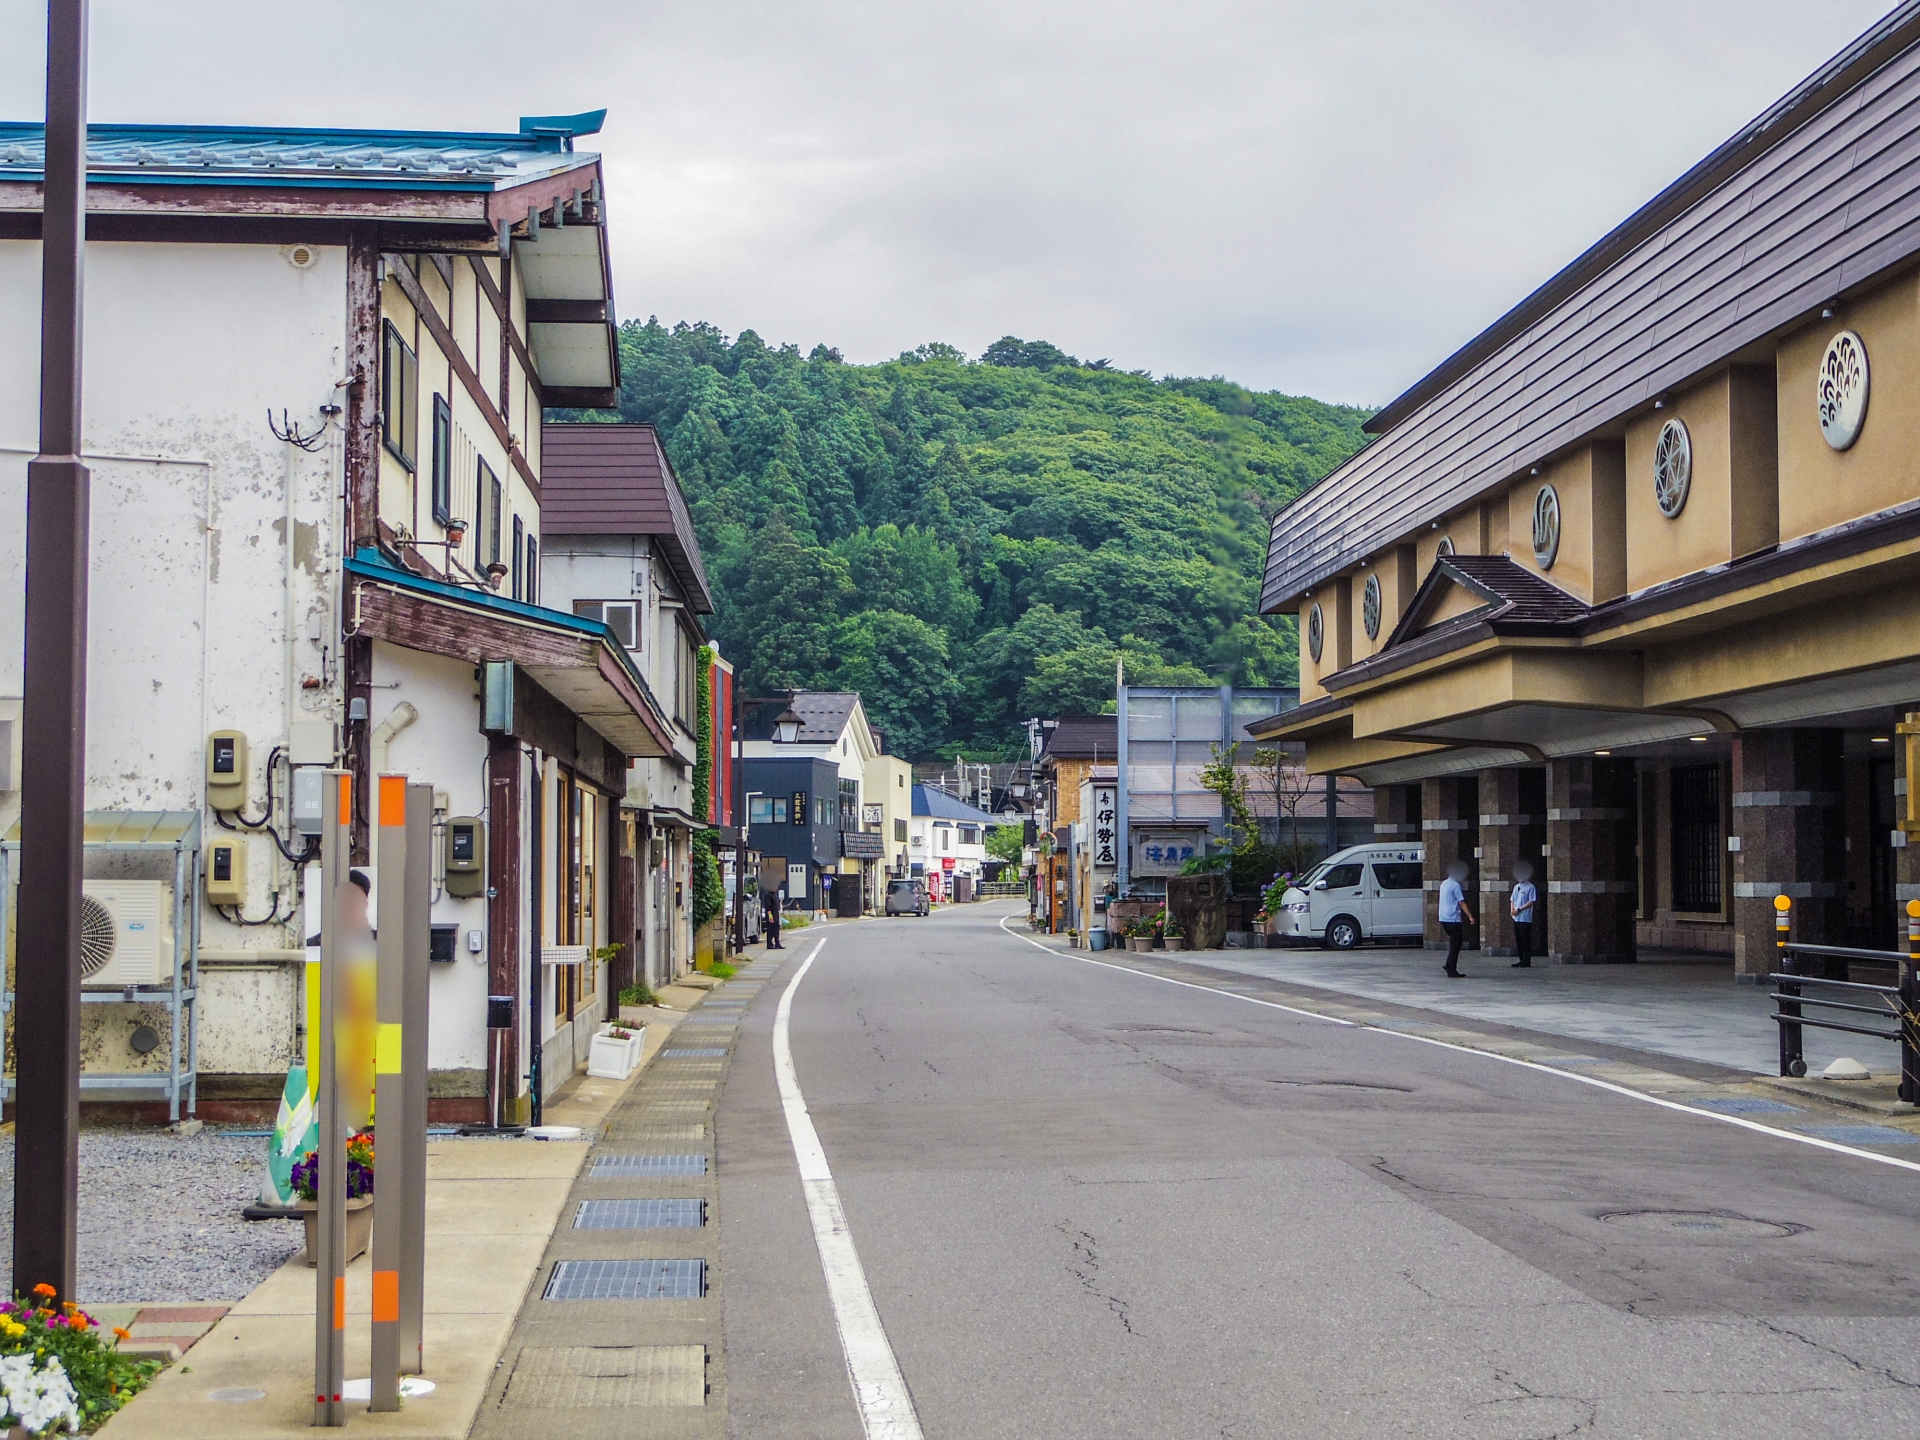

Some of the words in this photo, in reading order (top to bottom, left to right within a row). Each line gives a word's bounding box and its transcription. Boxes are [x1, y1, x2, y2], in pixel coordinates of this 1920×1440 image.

[867, 808, 880, 822] 酒
[1096, 809, 1115, 862] 伊勢屋
